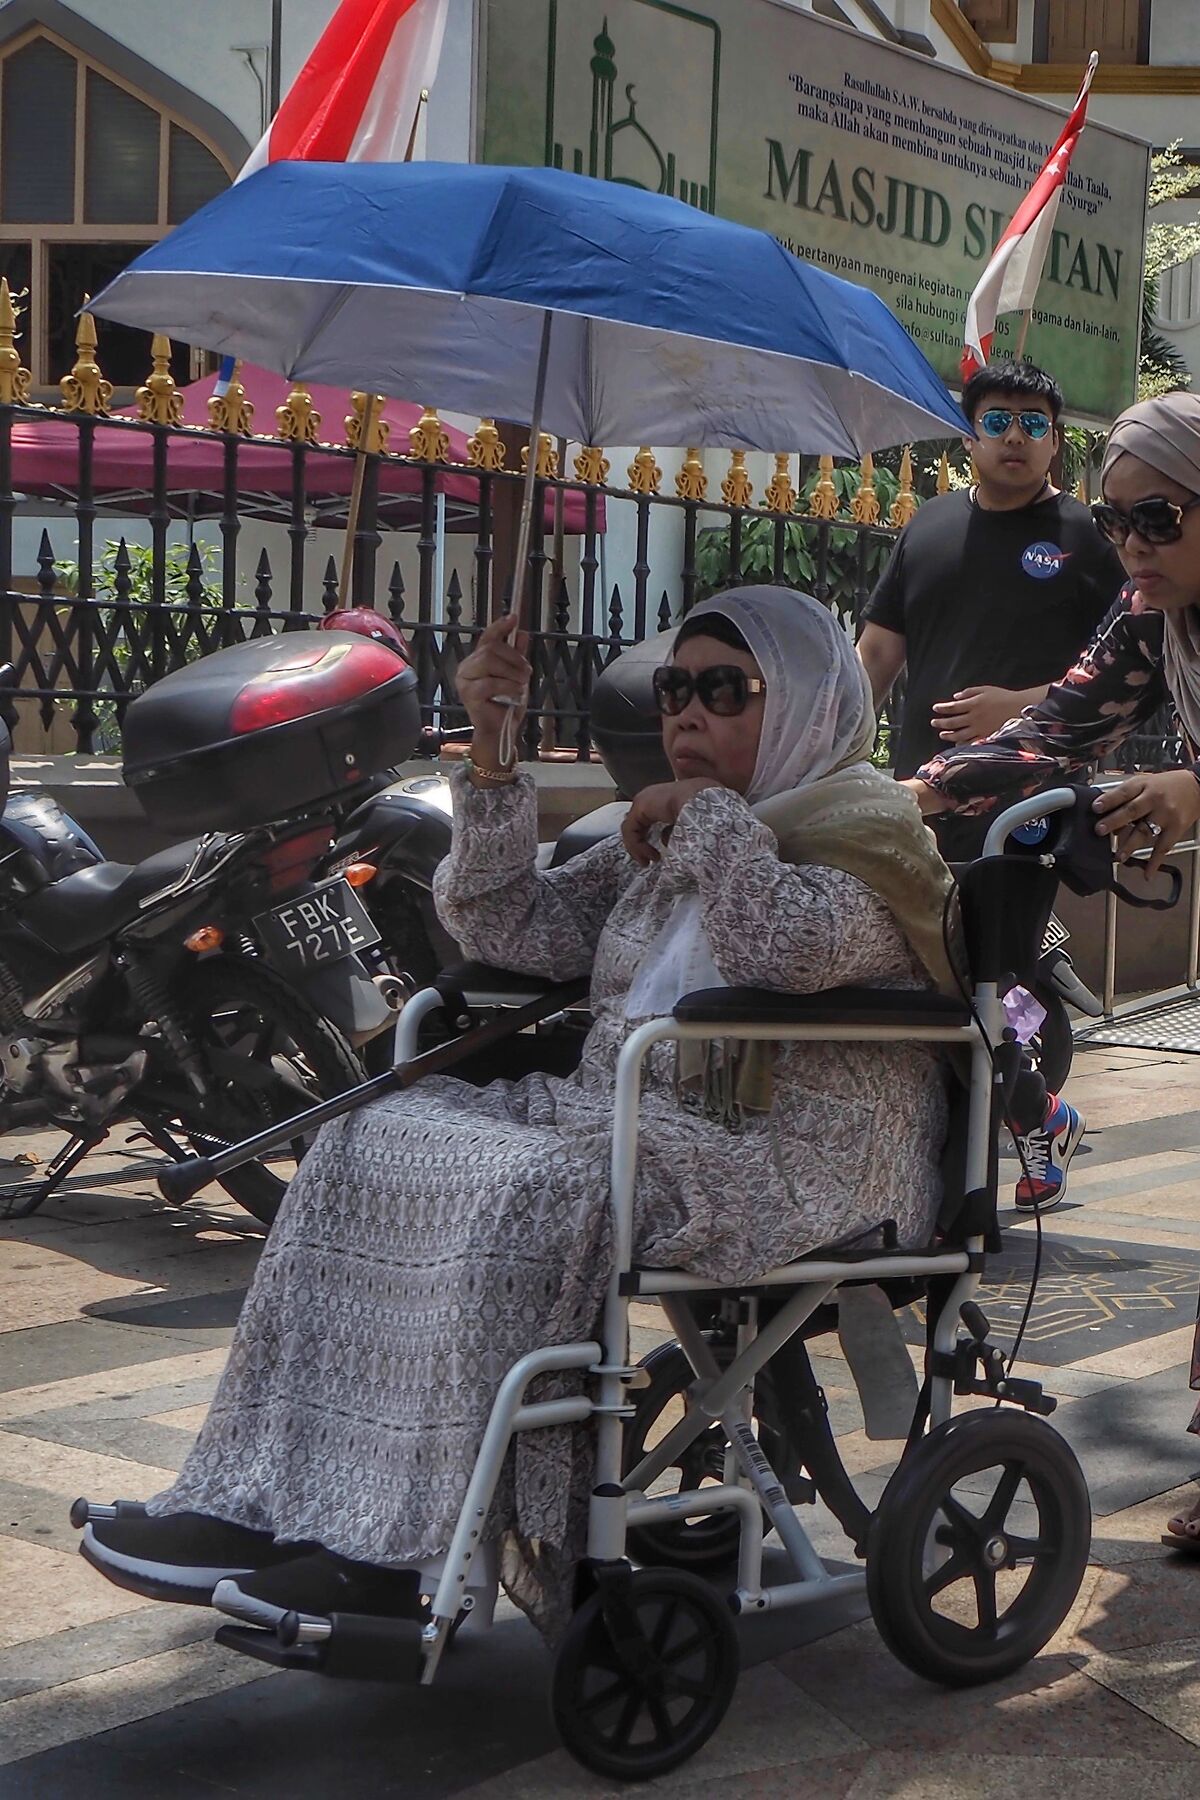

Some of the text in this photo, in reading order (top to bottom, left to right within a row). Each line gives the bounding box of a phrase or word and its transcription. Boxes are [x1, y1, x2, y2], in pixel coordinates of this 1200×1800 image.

[798, 102, 828, 124] maka
[831, 110, 860, 135] Allah
[863, 122, 889, 144] akan
[892, 135, 938, 161] membina
[941, 150, 987, 178] untuknya
[989, 166, 1022, 189] sebuah
[866, 104, 891, 127] yang
[894, 114, 956, 146] membangun
[958, 135, 991, 158] sebuah
[994, 148, 1025, 170] masjid
[1086, 177, 1112, 200] Taala,
[922, 99, 957, 124] bersabda
[958, 117, 977, 134] yang
[978, 121, 1027, 150] diriwayatkan
[1028, 140, 1043, 155] oleh
[763, 137, 1124, 302] MASJID STAN
[797, 244, 861, 273] pertanyaan
[863, 262, 916, 287] mengenai
[918, 273, 962, 298] kegiatan
[1032, 309, 1062, 325] agama
[1064, 315, 1081, 331] dan
[1083, 319, 1120, 343] lain-lain,
[896, 295, 913, 311] sila
[916, 301, 958, 325] hubungi
[1024, 551, 1060, 569] NASA
[279, 894, 340, 938] FBK
[286, 916, 365, 966] 727E
